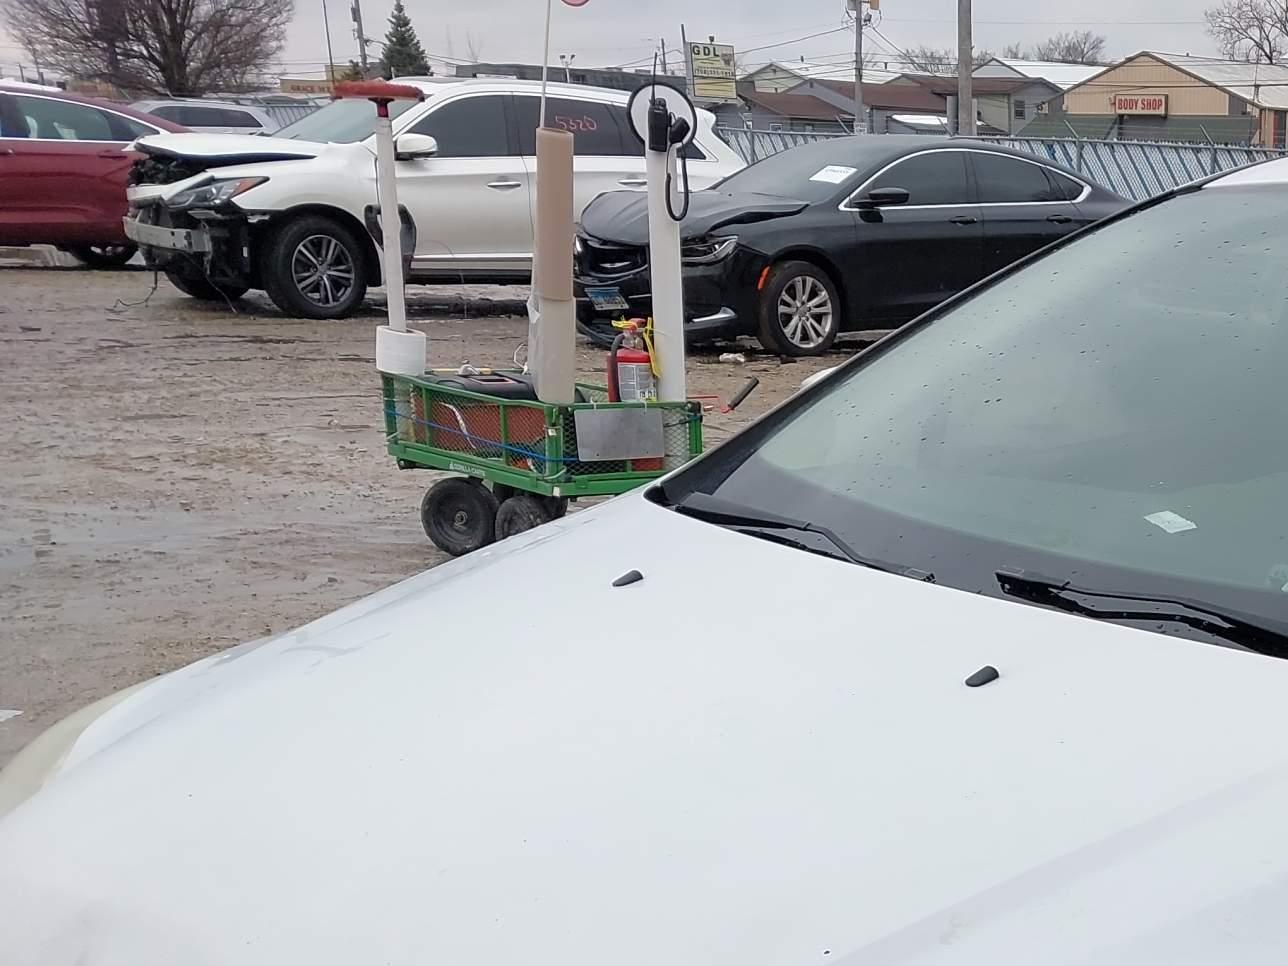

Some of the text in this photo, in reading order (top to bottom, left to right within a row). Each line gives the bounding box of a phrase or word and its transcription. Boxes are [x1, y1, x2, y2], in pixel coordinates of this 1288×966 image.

[692, 45, 720, 57] GDL
[1117, 98, 1163, 110] BODY SHOP
